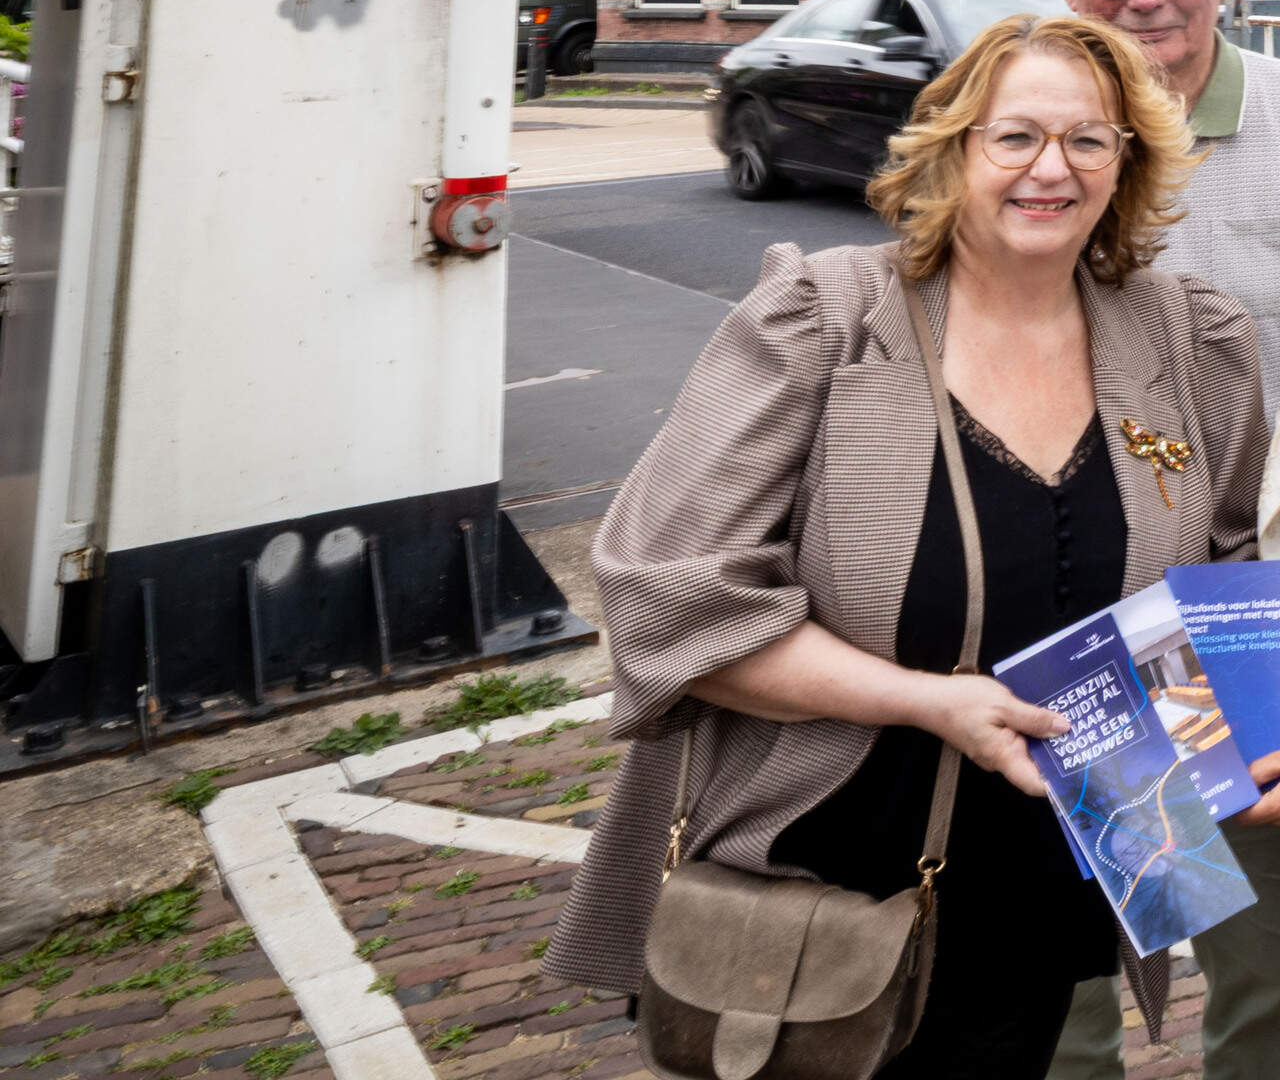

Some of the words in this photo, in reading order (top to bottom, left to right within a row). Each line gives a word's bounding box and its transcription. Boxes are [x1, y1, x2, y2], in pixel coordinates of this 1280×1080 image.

[1184, 613, 1241, 623] vesteringen
[1242, 610, 1263, 619] met
[1228, 601, 1251, 611] voor
[1185, 623, 1208, 636] pact
[1238, 631, 1260, 640] voor
[1047, 670, 1115, 713] SSENZIJL
[1062, 693, 1100, 722] RIJDT
[1103, 683, 1122, 702] AL
[1054, 729, 1100, 757] VOOR
[1100, 711, 1131, 736] EEN
[1071, 708, 1108, 738] JAAR
[1063, 725, 1135, 770] RANDWEG
